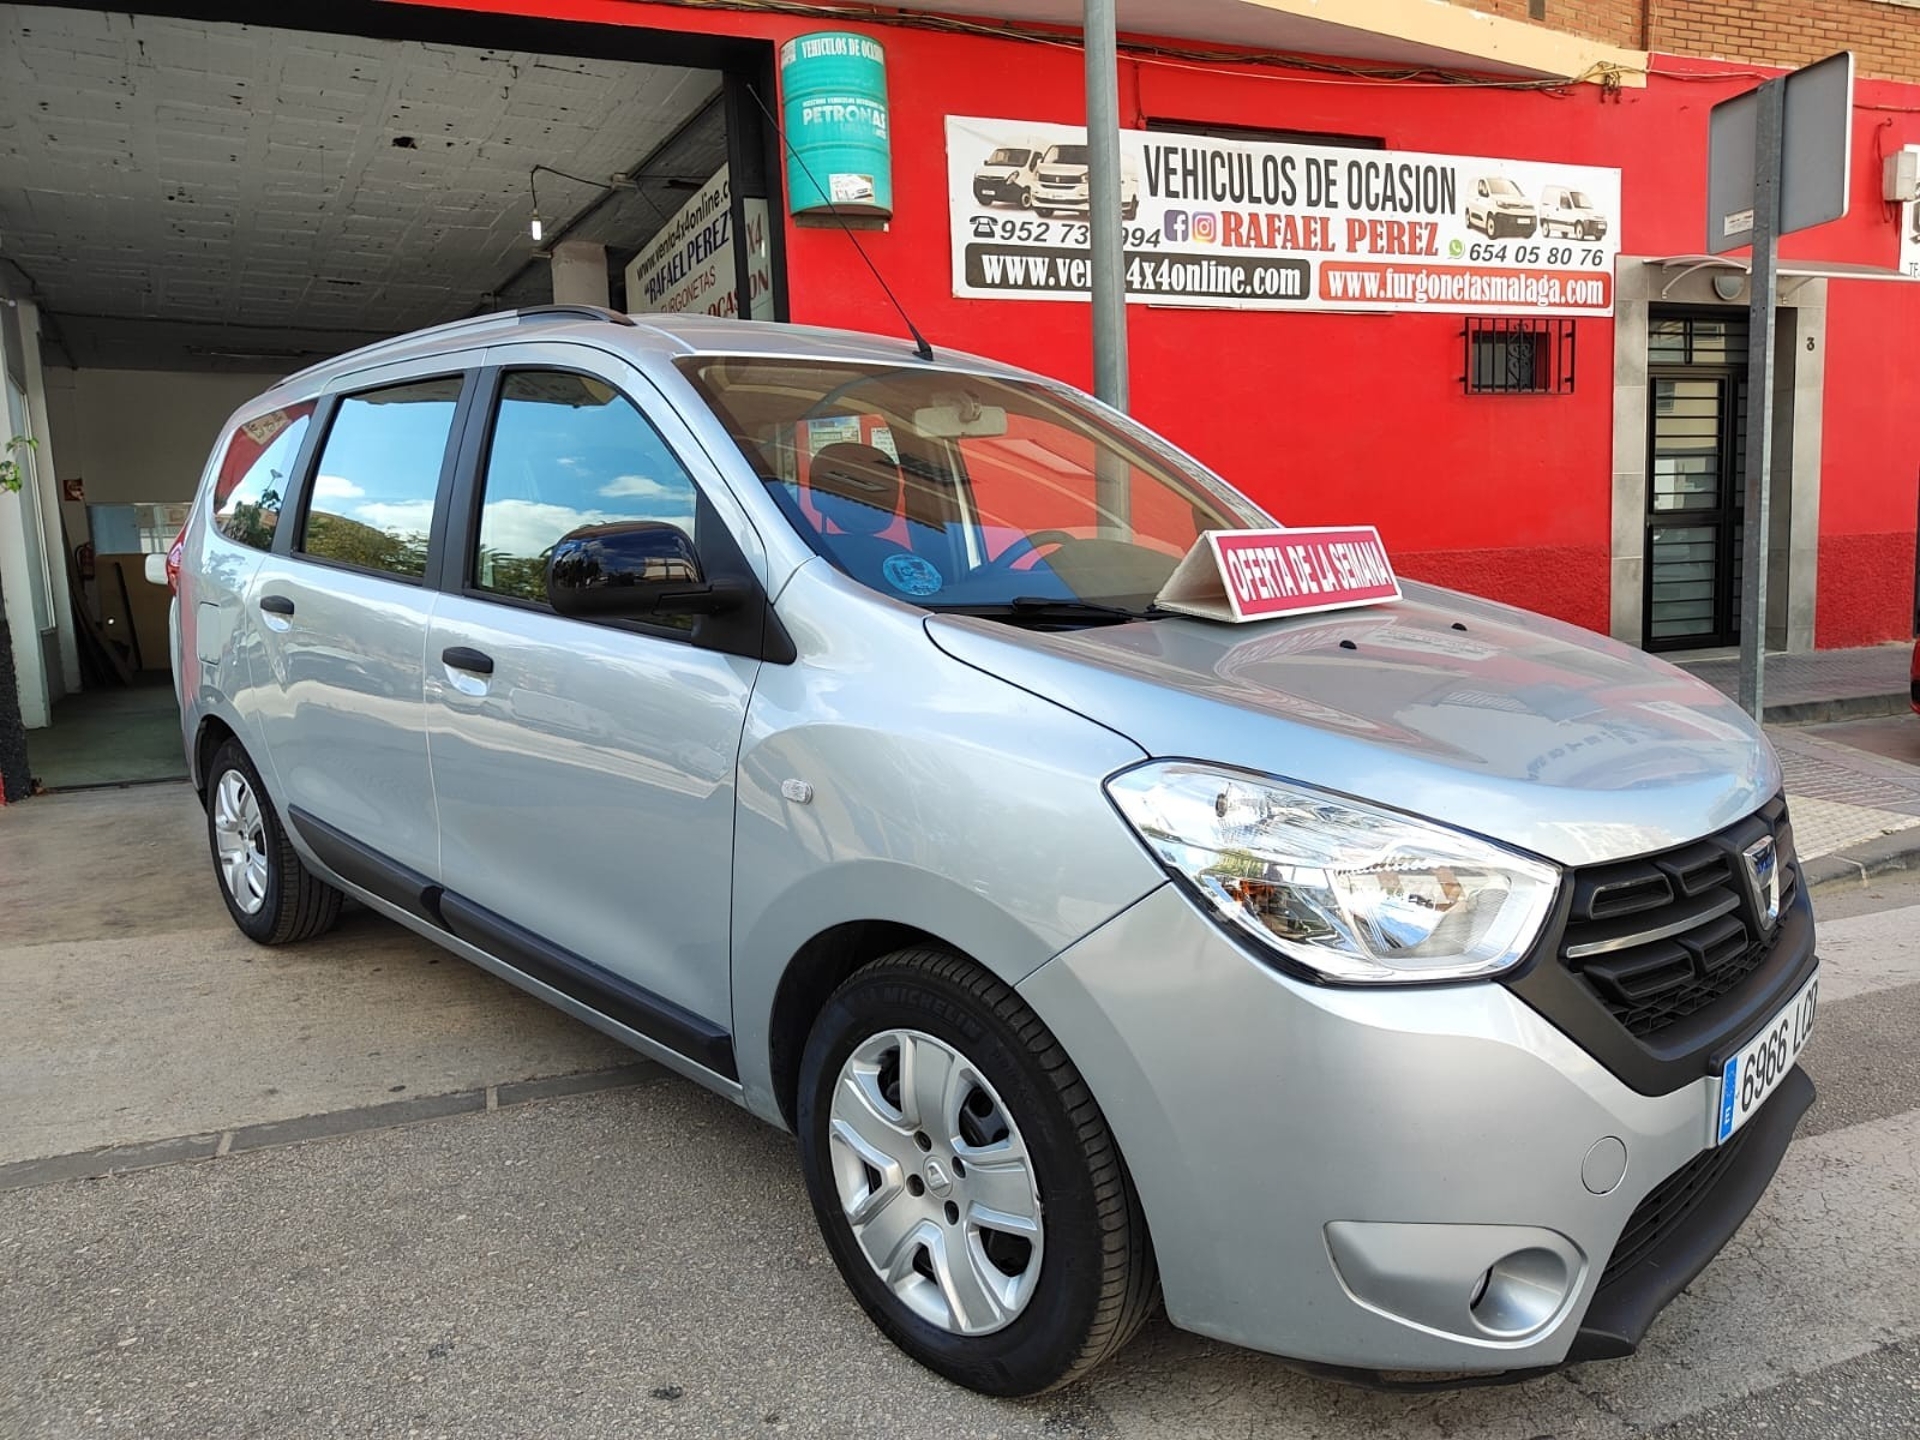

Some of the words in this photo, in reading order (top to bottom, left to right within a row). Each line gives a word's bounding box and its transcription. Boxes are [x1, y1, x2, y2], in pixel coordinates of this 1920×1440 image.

[801, 38, 846, 58] VEHICULOS
[848, 38, 860, 56] DE
[802, 104, 886, 130] PETRONAS
[1143, 144, 1297, 206] VEHICULOS
[1306, 157, 1338, 209] DE
[1347, 160, 1457, 215] OCASION
[999, 220, 1050, 242] 952
[1220, 210, 1336, 252] RAFAEL
[1345, 218, 1439, 256] PEREZ
[1469, 243, 1507, 263] 654
[1514, 245, 1541, 264] 05
[1547, 247, 1572, 266] 80
[1579, 248, 1604, 266] 76
[1327, 267, 1604, 306] www.furgonetasmalaga.com
[1806, 336, 1815, 351] 3
[1226, 547, 1299, 602] OFERTA
[1291, 545, 1319, 594] DE
[1310, 543, 1340, 592] LA
[1328, 541, 1393, 589] SEMANA
[883, 986, 982, 1040] MICHELIN
[1741, 1018, 1789, 1113] 6966
